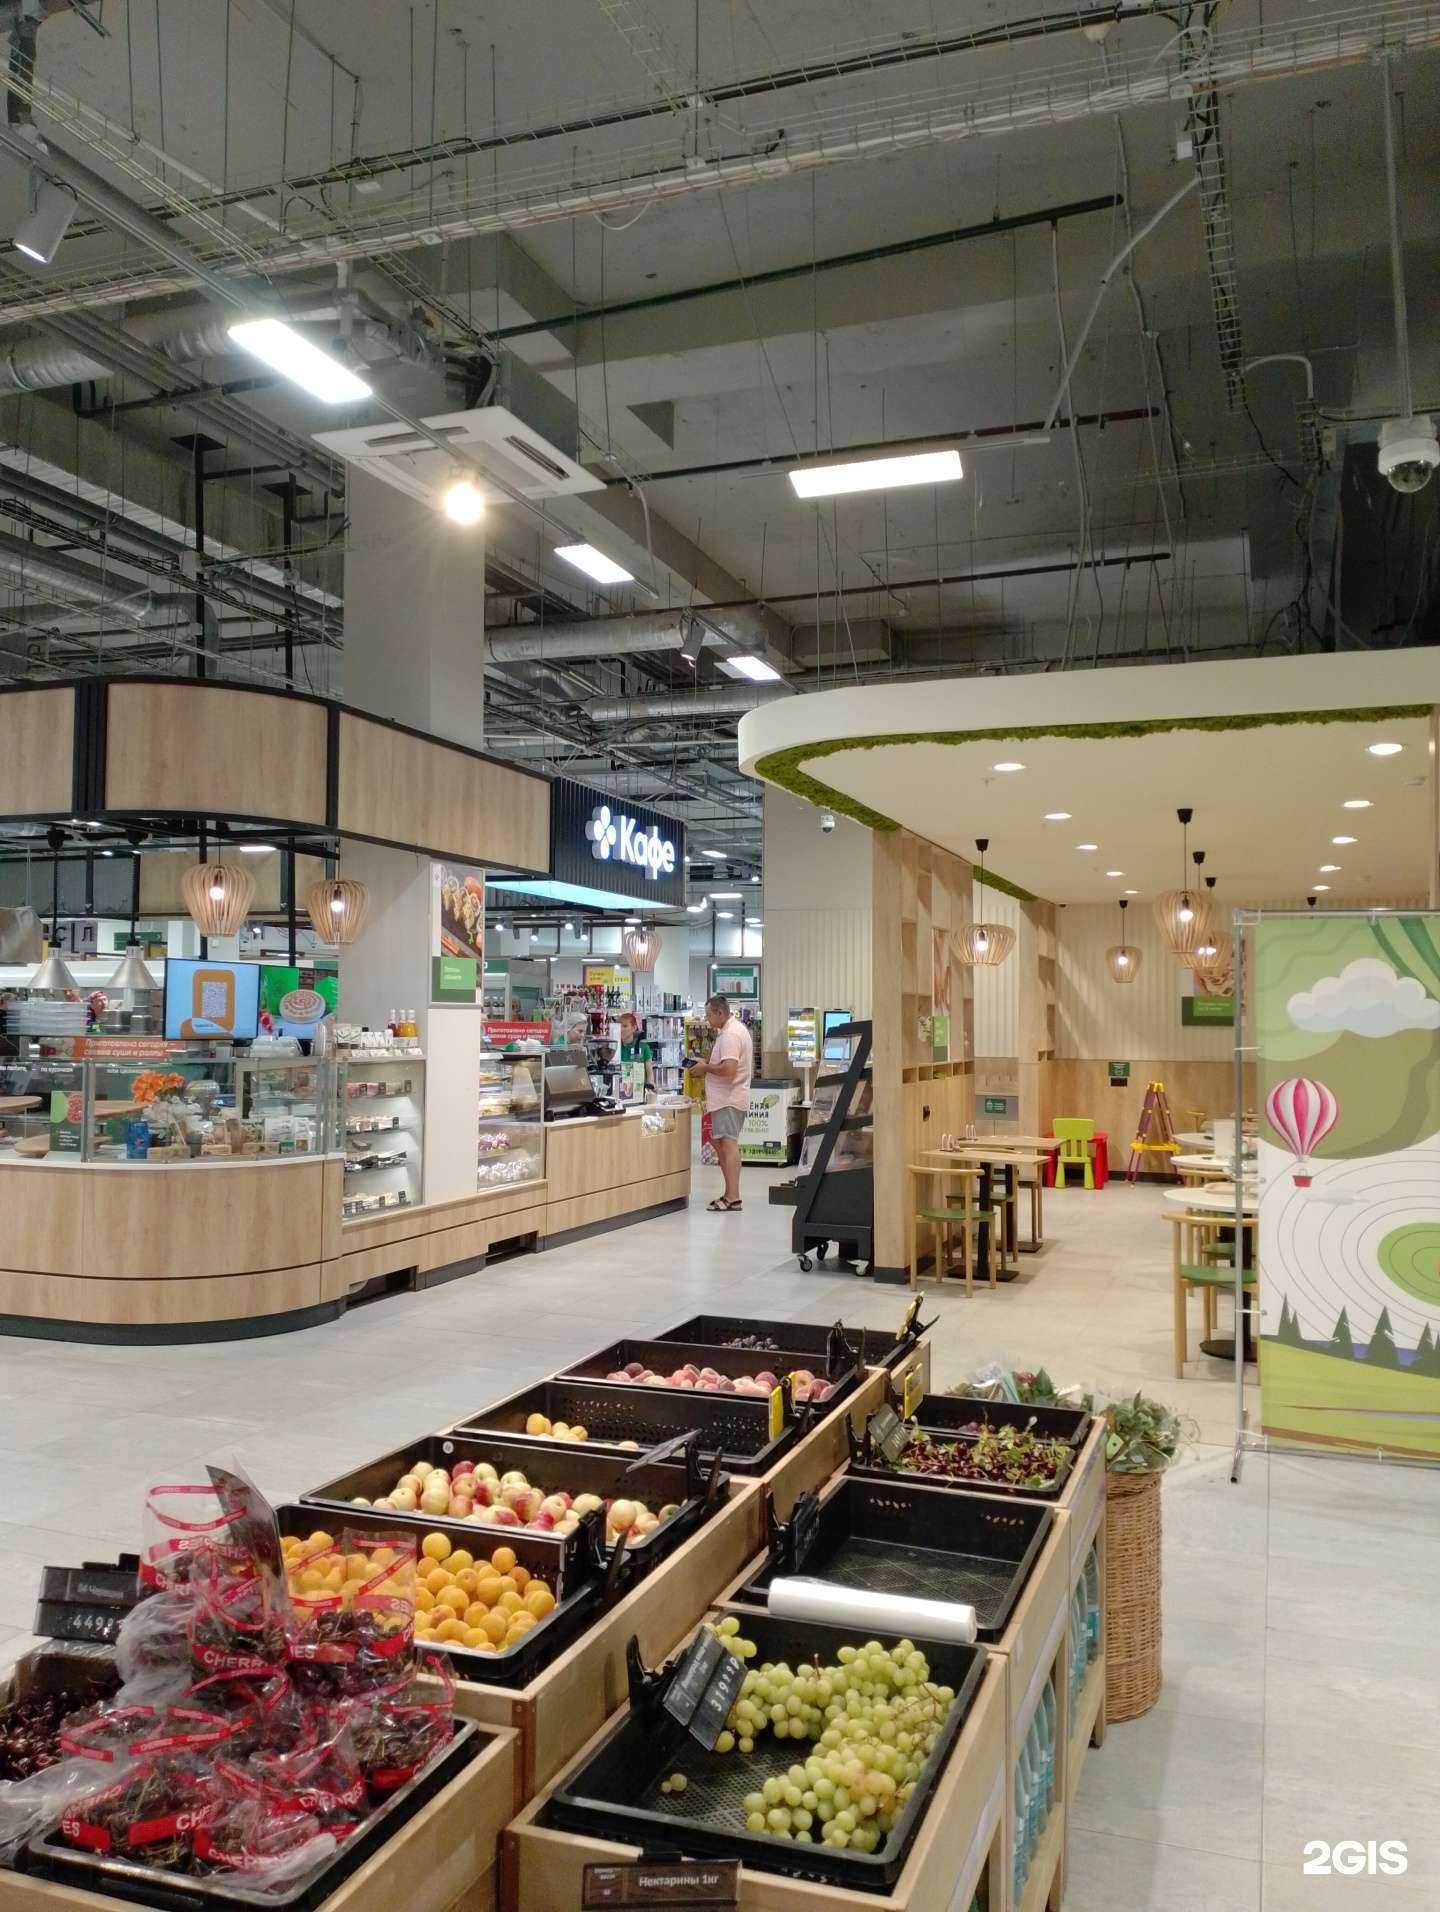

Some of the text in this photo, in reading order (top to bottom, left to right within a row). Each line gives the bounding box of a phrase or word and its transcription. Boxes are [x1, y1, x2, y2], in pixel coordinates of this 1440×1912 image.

[616, 814, 675, 881] Кафе
[639, 1874, 719, 1887] Нектарины 1кг
